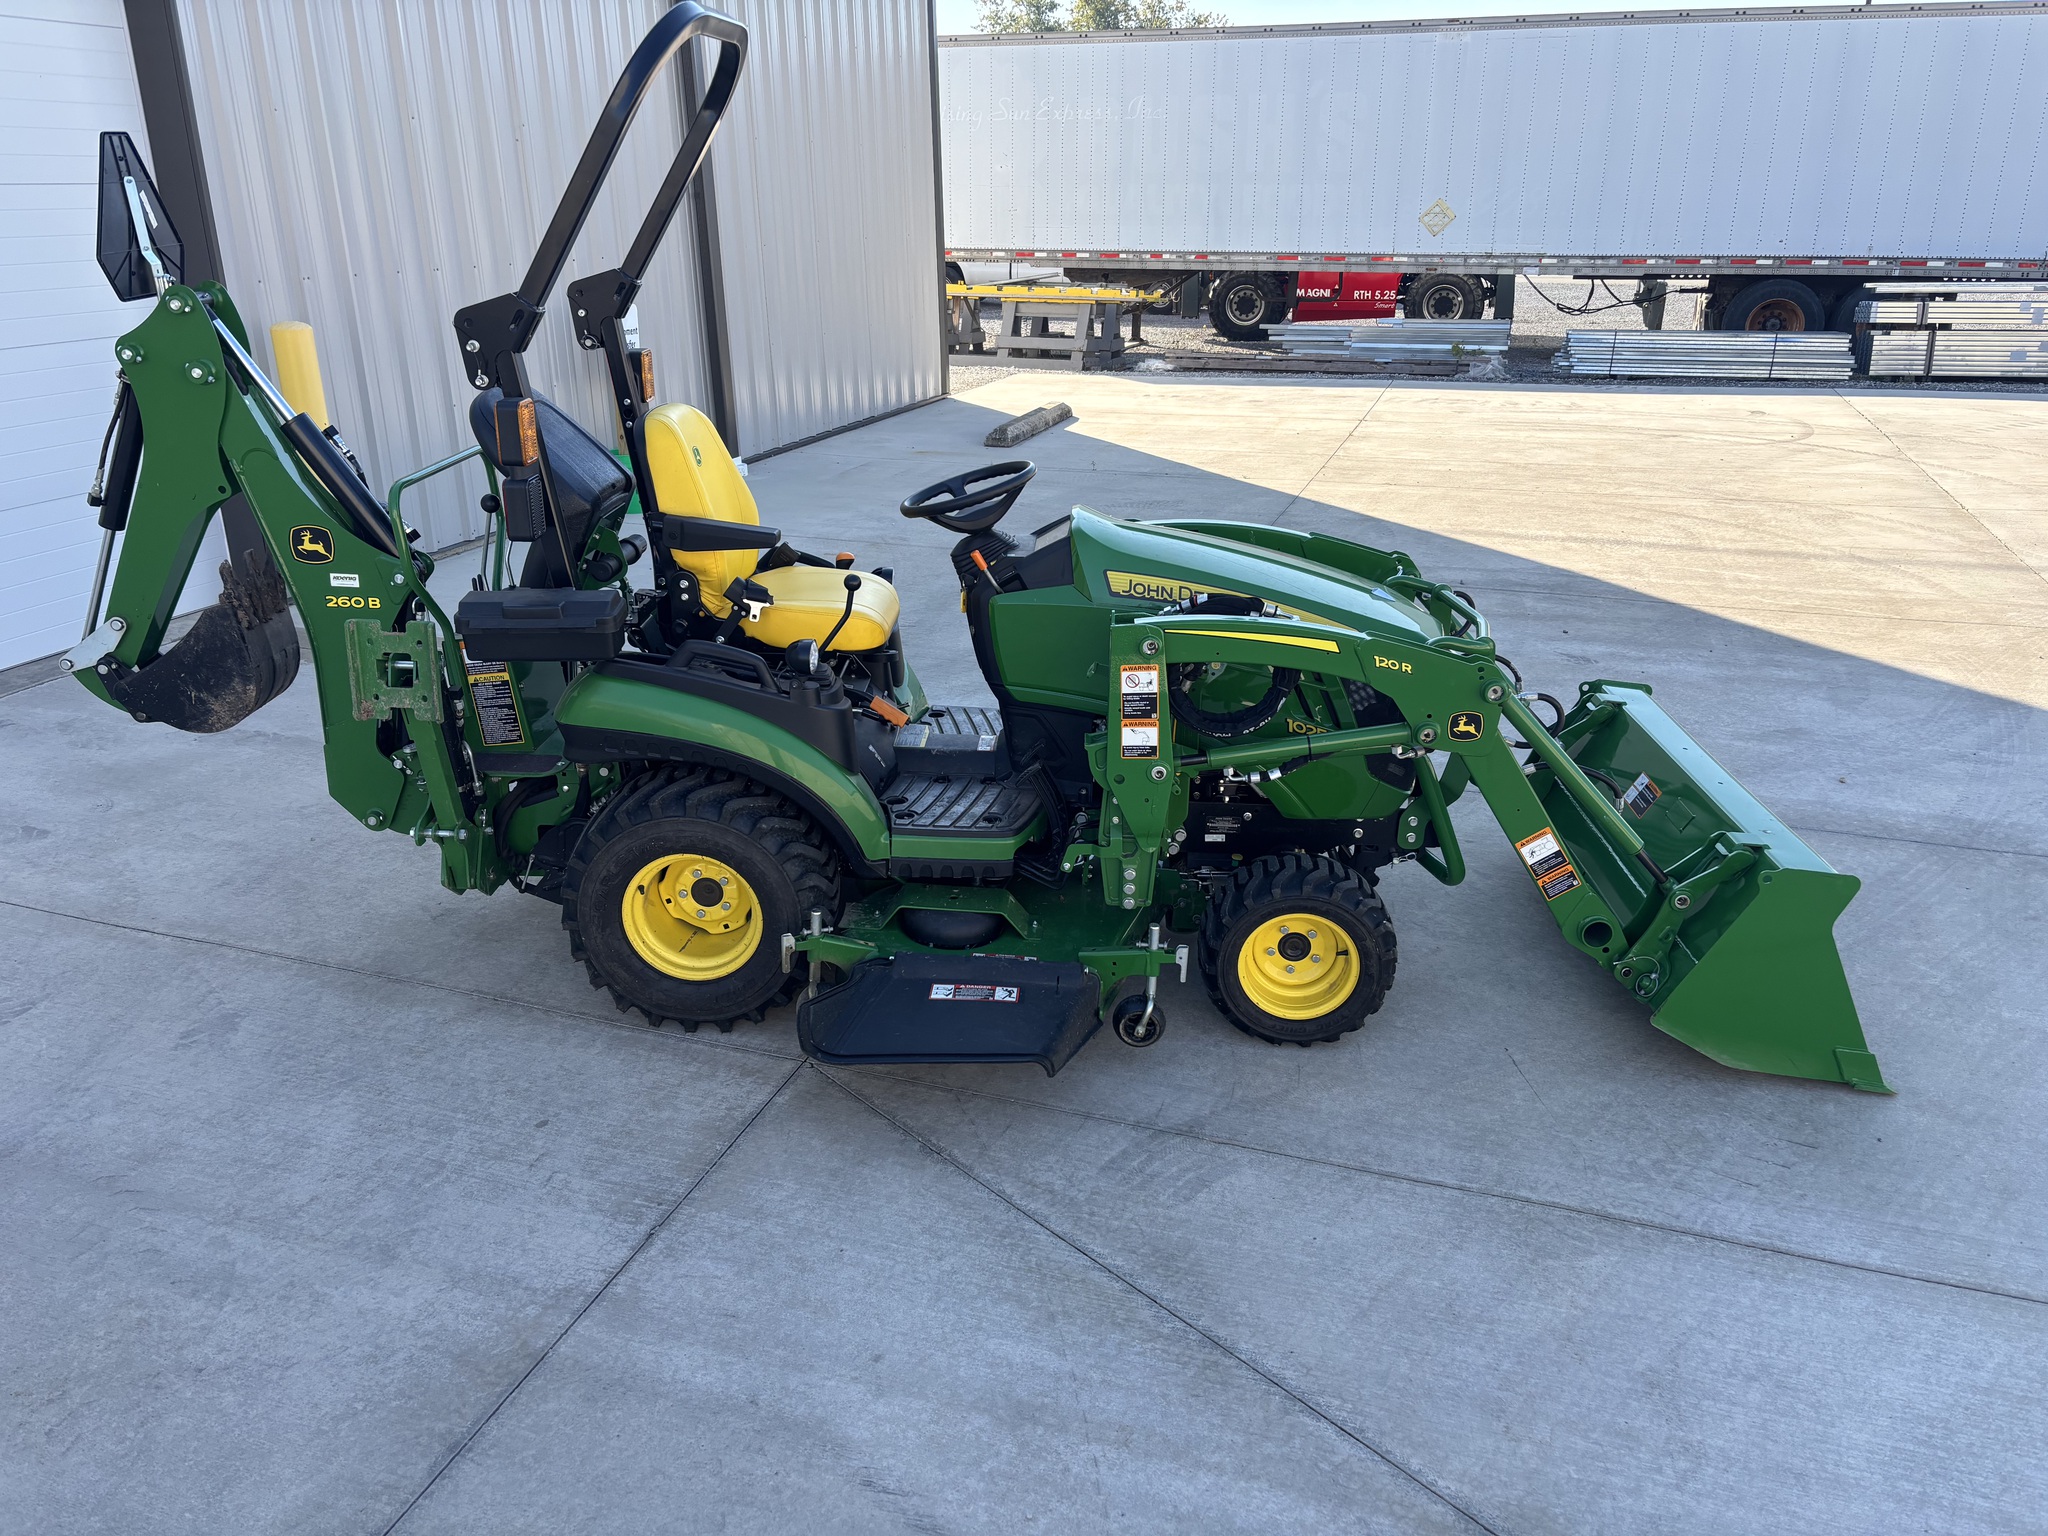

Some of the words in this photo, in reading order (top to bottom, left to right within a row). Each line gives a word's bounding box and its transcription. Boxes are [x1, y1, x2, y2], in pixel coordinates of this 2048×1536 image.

[941, 105, 983, 131] ising
[988, 97, 1030, 121] Sun
[1296, 288, 1331, 298] MAGNI
[1353, 290, 1372, 300] RTH
[1374, 290, 1396, 300] 5.25
[1121, 579, 1174, 600] JOHN
[325, 595, 365, 609] 260
[367, 596, 381, 609] B
[1373, 655, 1400, 671] 120
[1401, 662, 1412, 674] R
